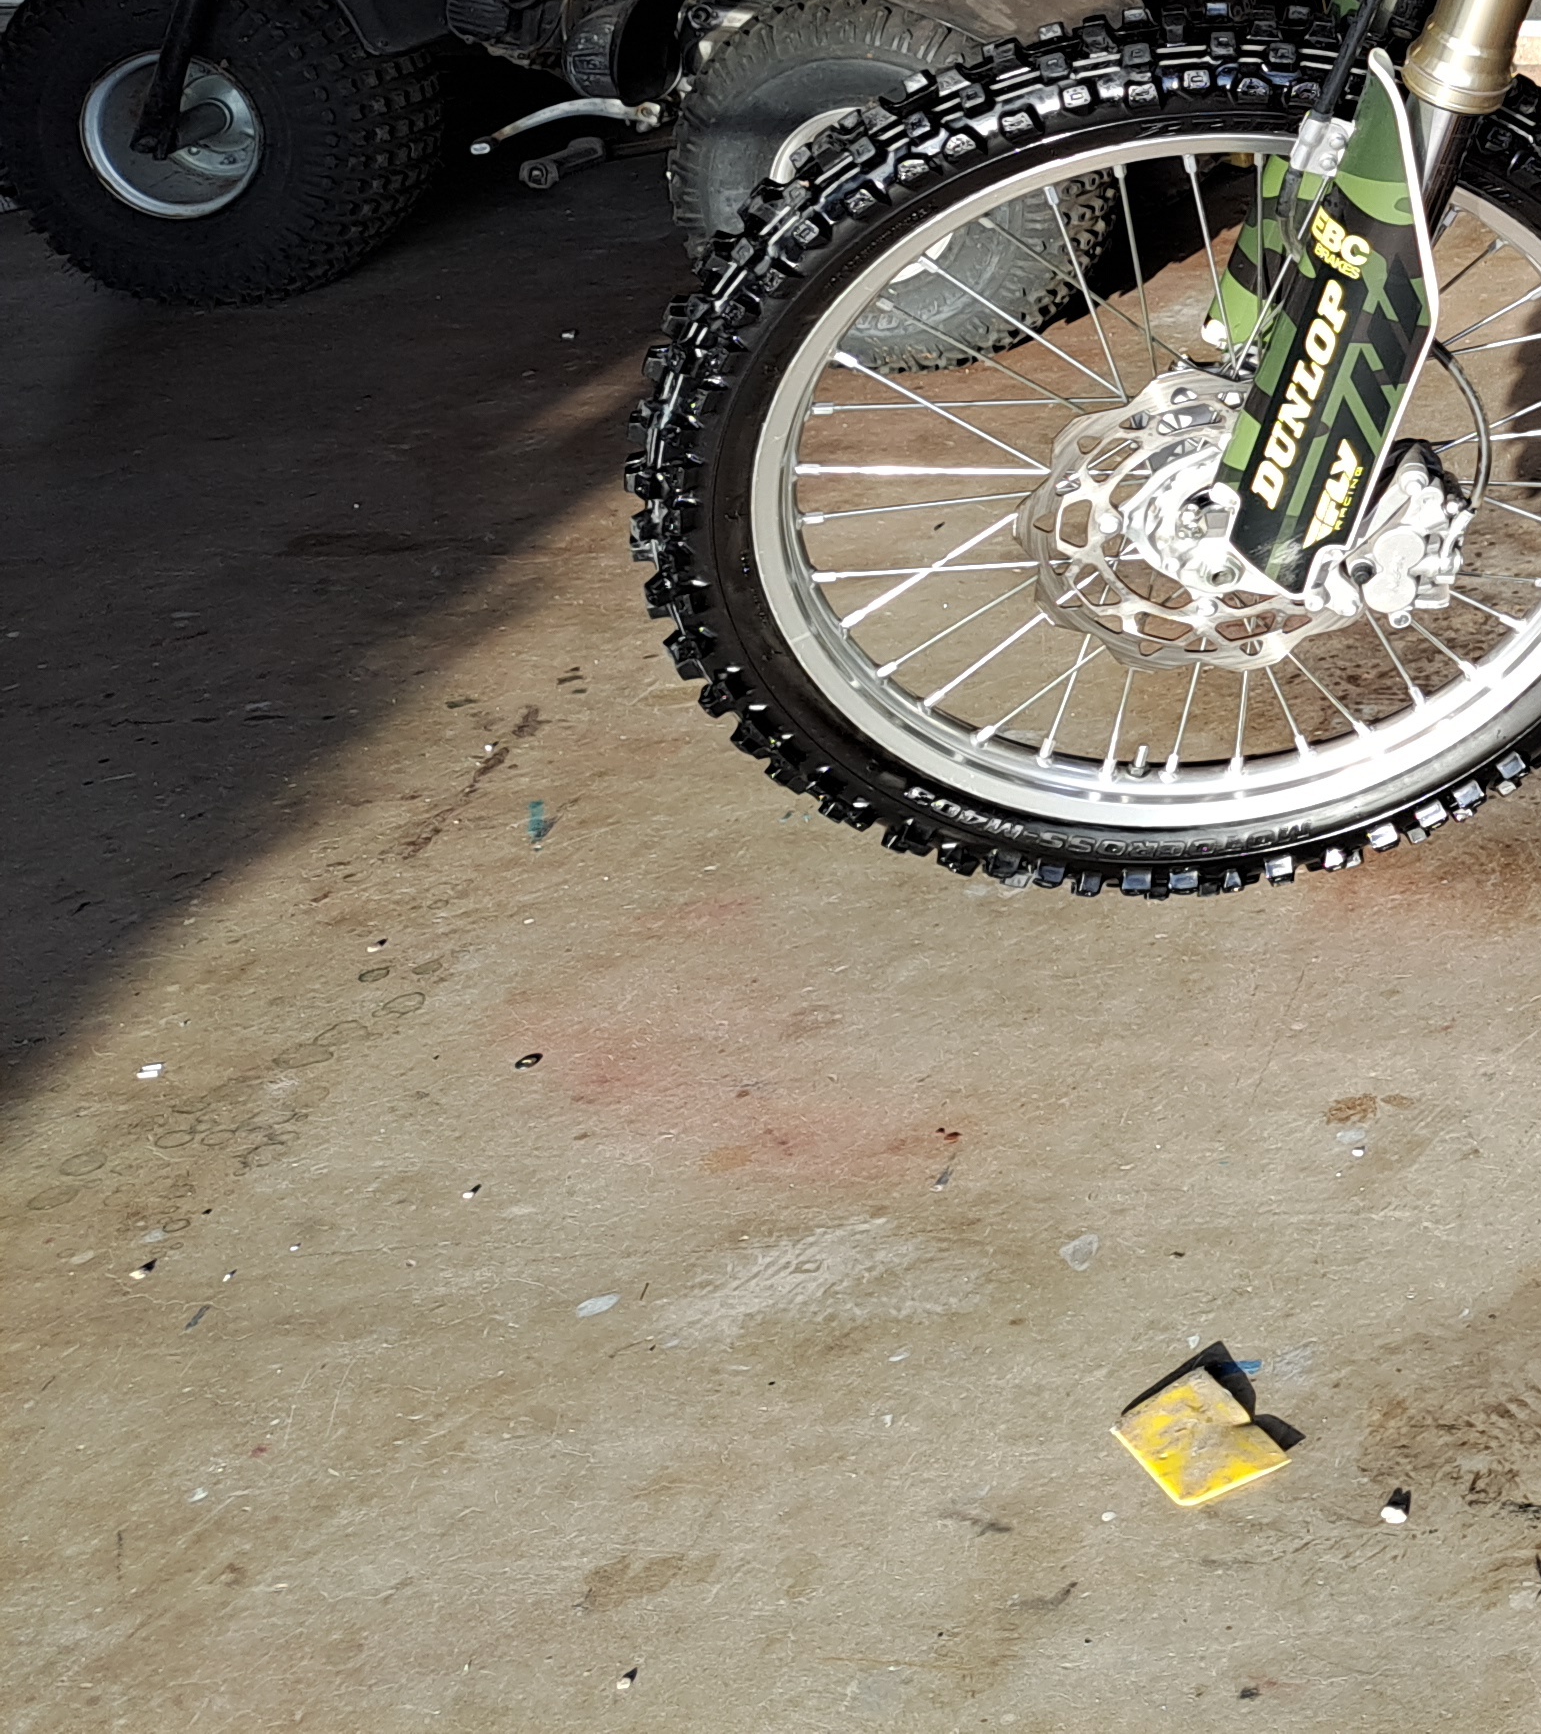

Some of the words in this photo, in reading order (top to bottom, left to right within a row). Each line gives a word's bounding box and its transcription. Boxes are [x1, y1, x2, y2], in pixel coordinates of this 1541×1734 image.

[1311, 205, 1370, 266] EBC
[1314, 242, 1361, 280] BRAKES
[1251, 280, 1347, 511] DUNLOP
[1302, 438, 1358, 549] FLY
